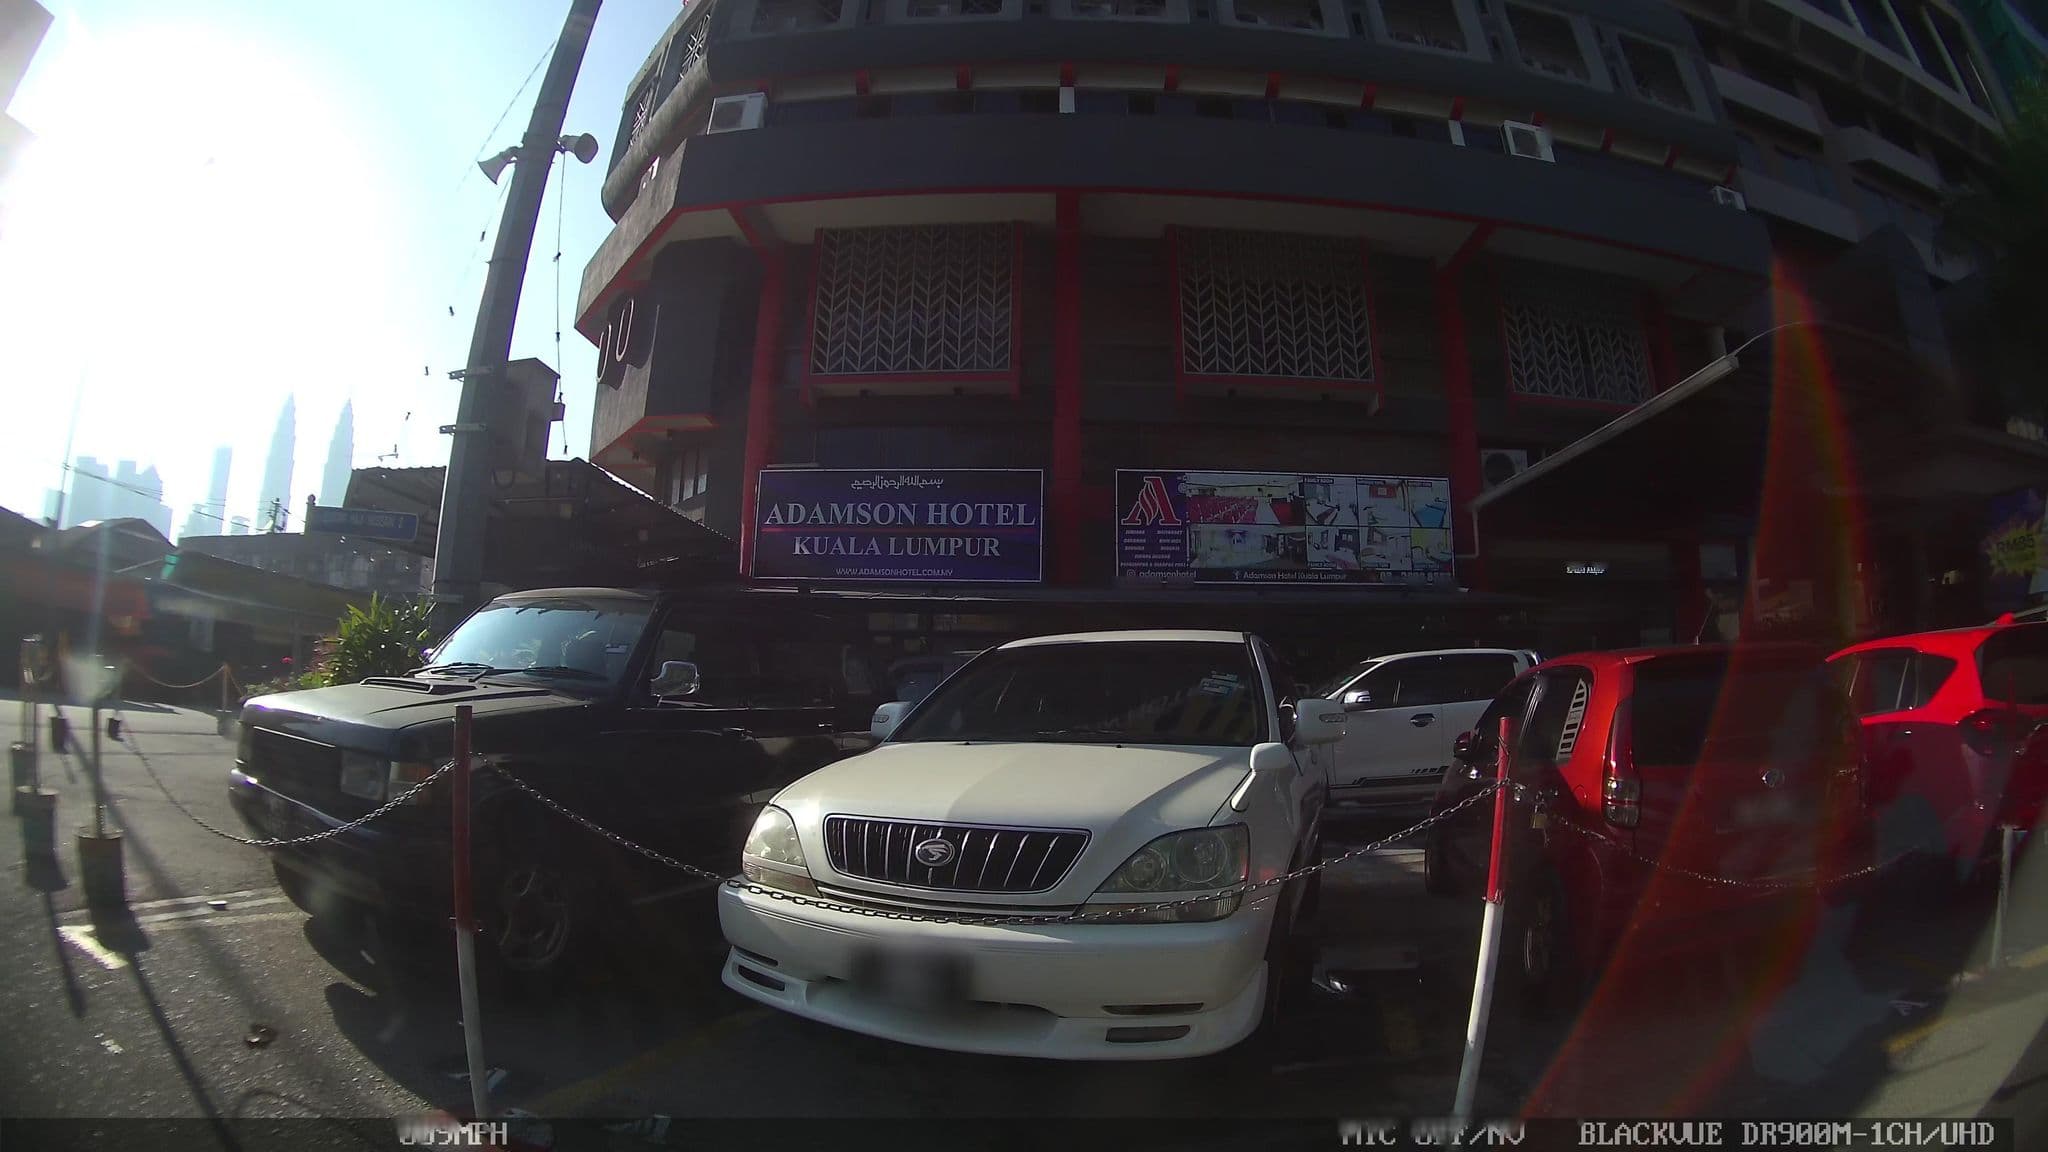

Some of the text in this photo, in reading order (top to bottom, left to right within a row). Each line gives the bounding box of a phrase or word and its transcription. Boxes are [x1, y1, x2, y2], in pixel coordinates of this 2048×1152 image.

[763, 503, 1036, 526] ADAMSON HOTEL
[792, 536, 1001, 557] KUALA LUMPUR
[1243, 571, 1346, 583] Adamson Hotel Kuala Lumpur
